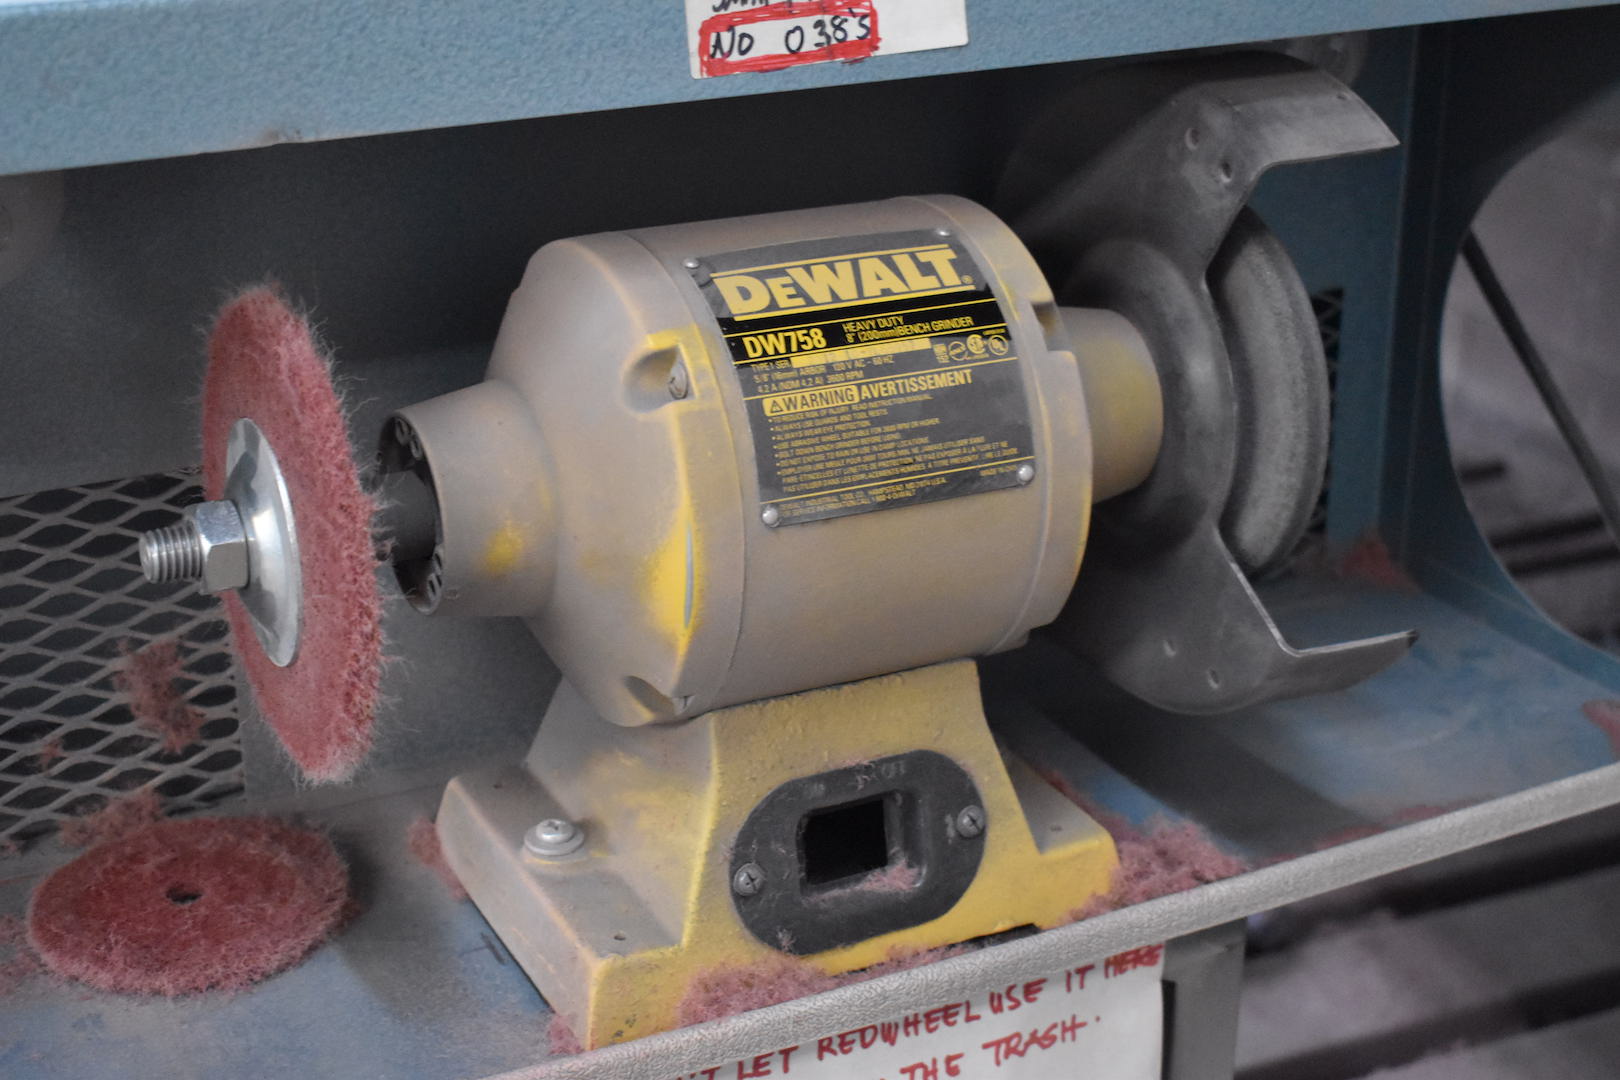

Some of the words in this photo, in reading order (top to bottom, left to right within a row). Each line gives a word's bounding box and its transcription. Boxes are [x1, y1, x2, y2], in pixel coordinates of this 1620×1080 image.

[842, 318, 878, 333] HEAVY
[879, 315, 904, 328] DUTY
[932, 316, 974, 332] GRINDER
[742, 328, 827, 358] DW758
[782, 387, 857, 411] WARNING
[860, 369, 973, 400] AVERTISSEMENT
[737, 1045, 799, 1080] LET
[989, 978, 1048, 1014] USE
[1065, 963, 1095, 993] IT
[900, 1053, 964, 1080] THE
